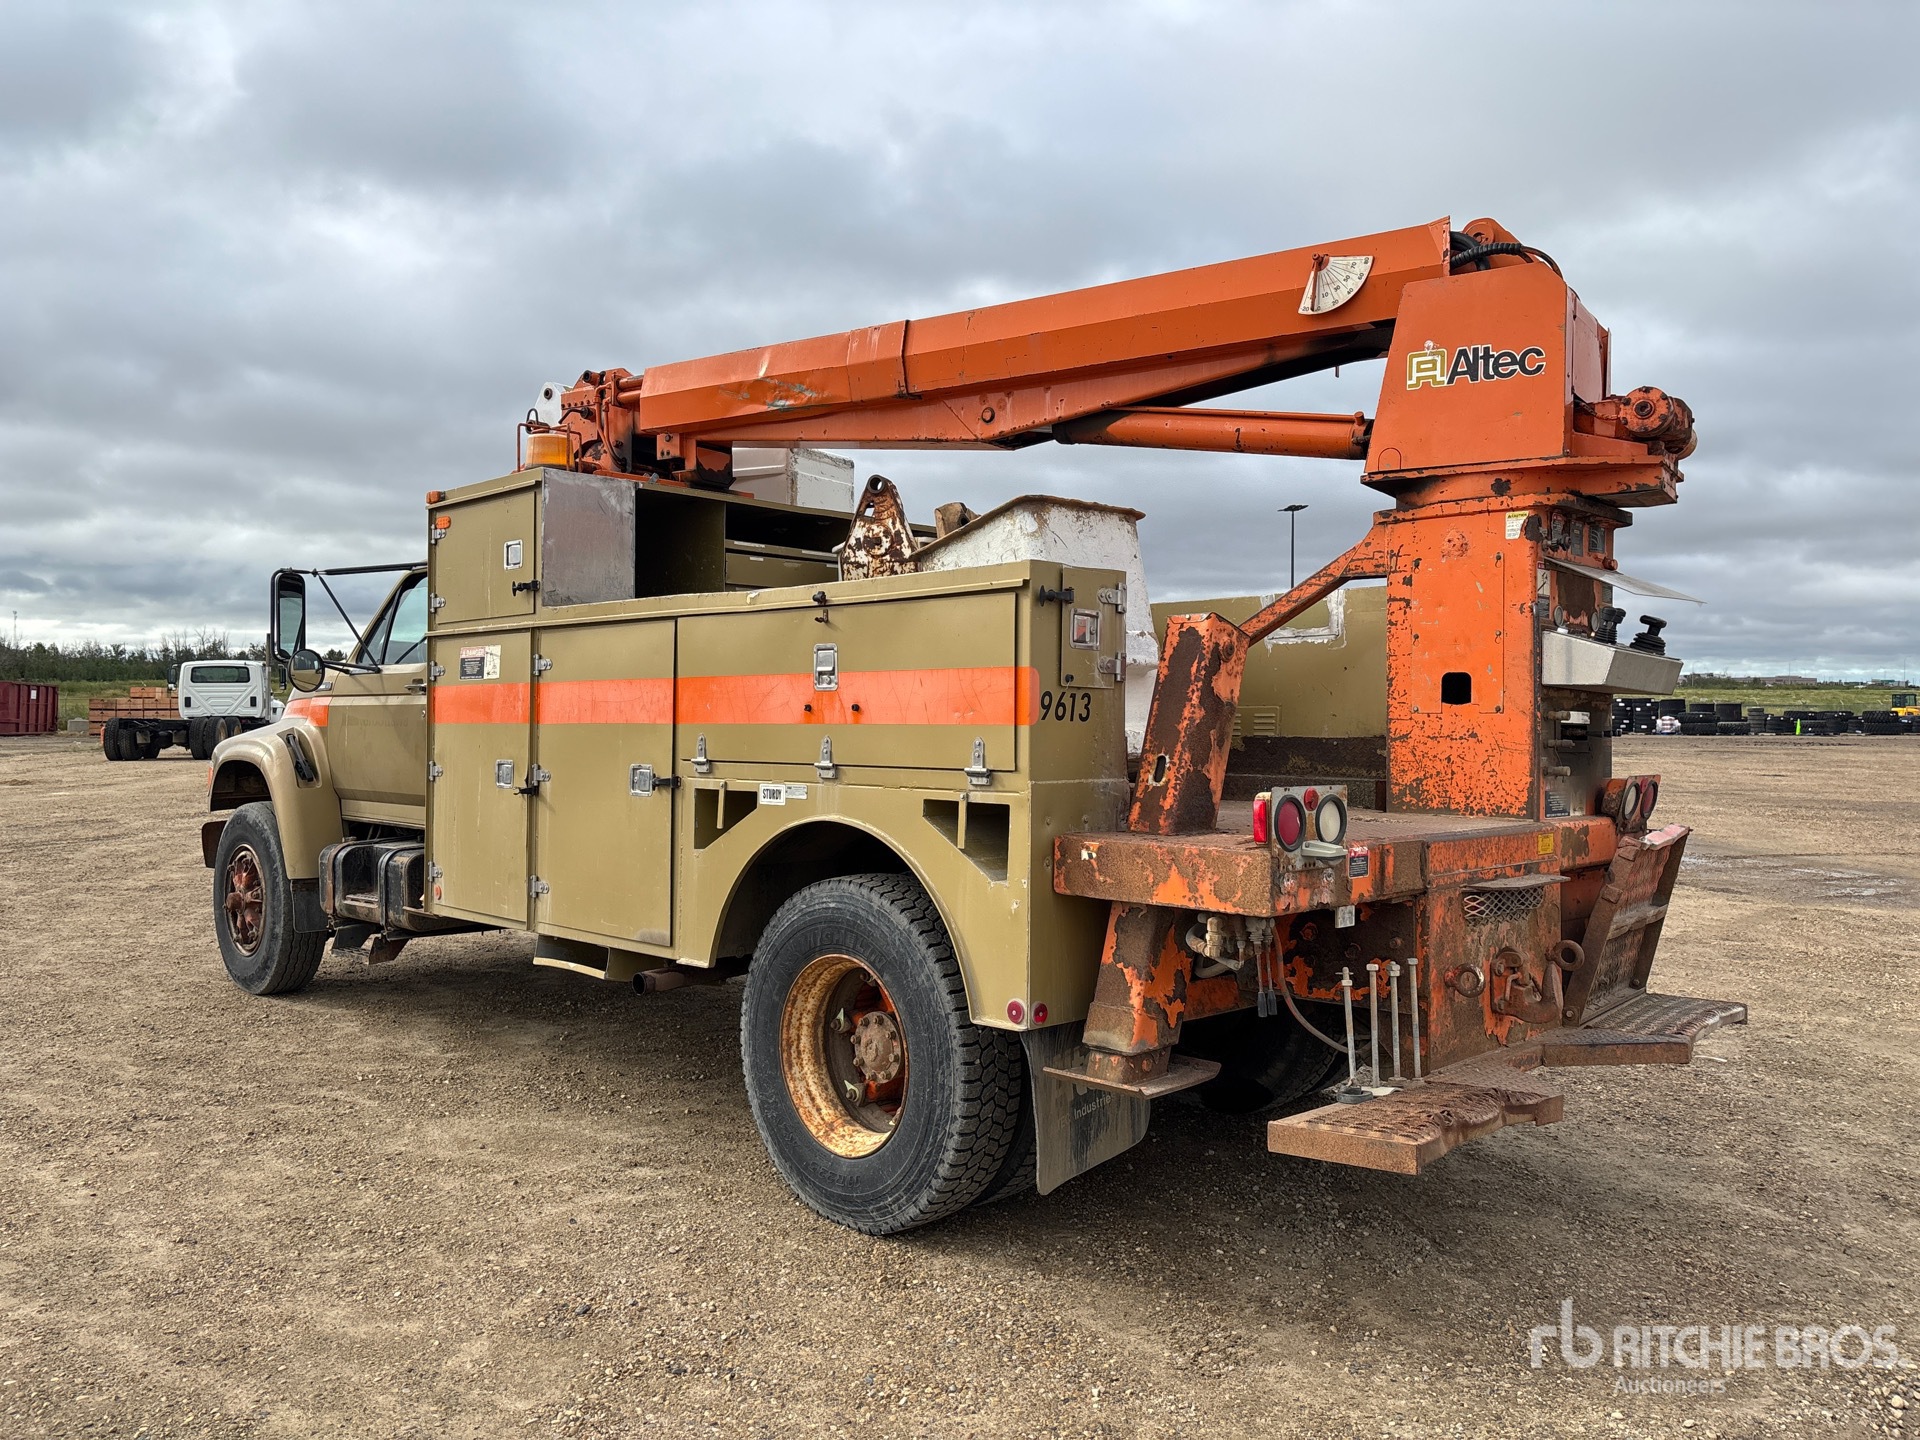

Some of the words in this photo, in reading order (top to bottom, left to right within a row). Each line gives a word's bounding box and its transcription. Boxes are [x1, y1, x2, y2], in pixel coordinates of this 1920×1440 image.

[1446, 345, 1546, 386] Altec
[1040, 690, 1092, 722] 9613
[762, 788, 782, 800] STURDY
